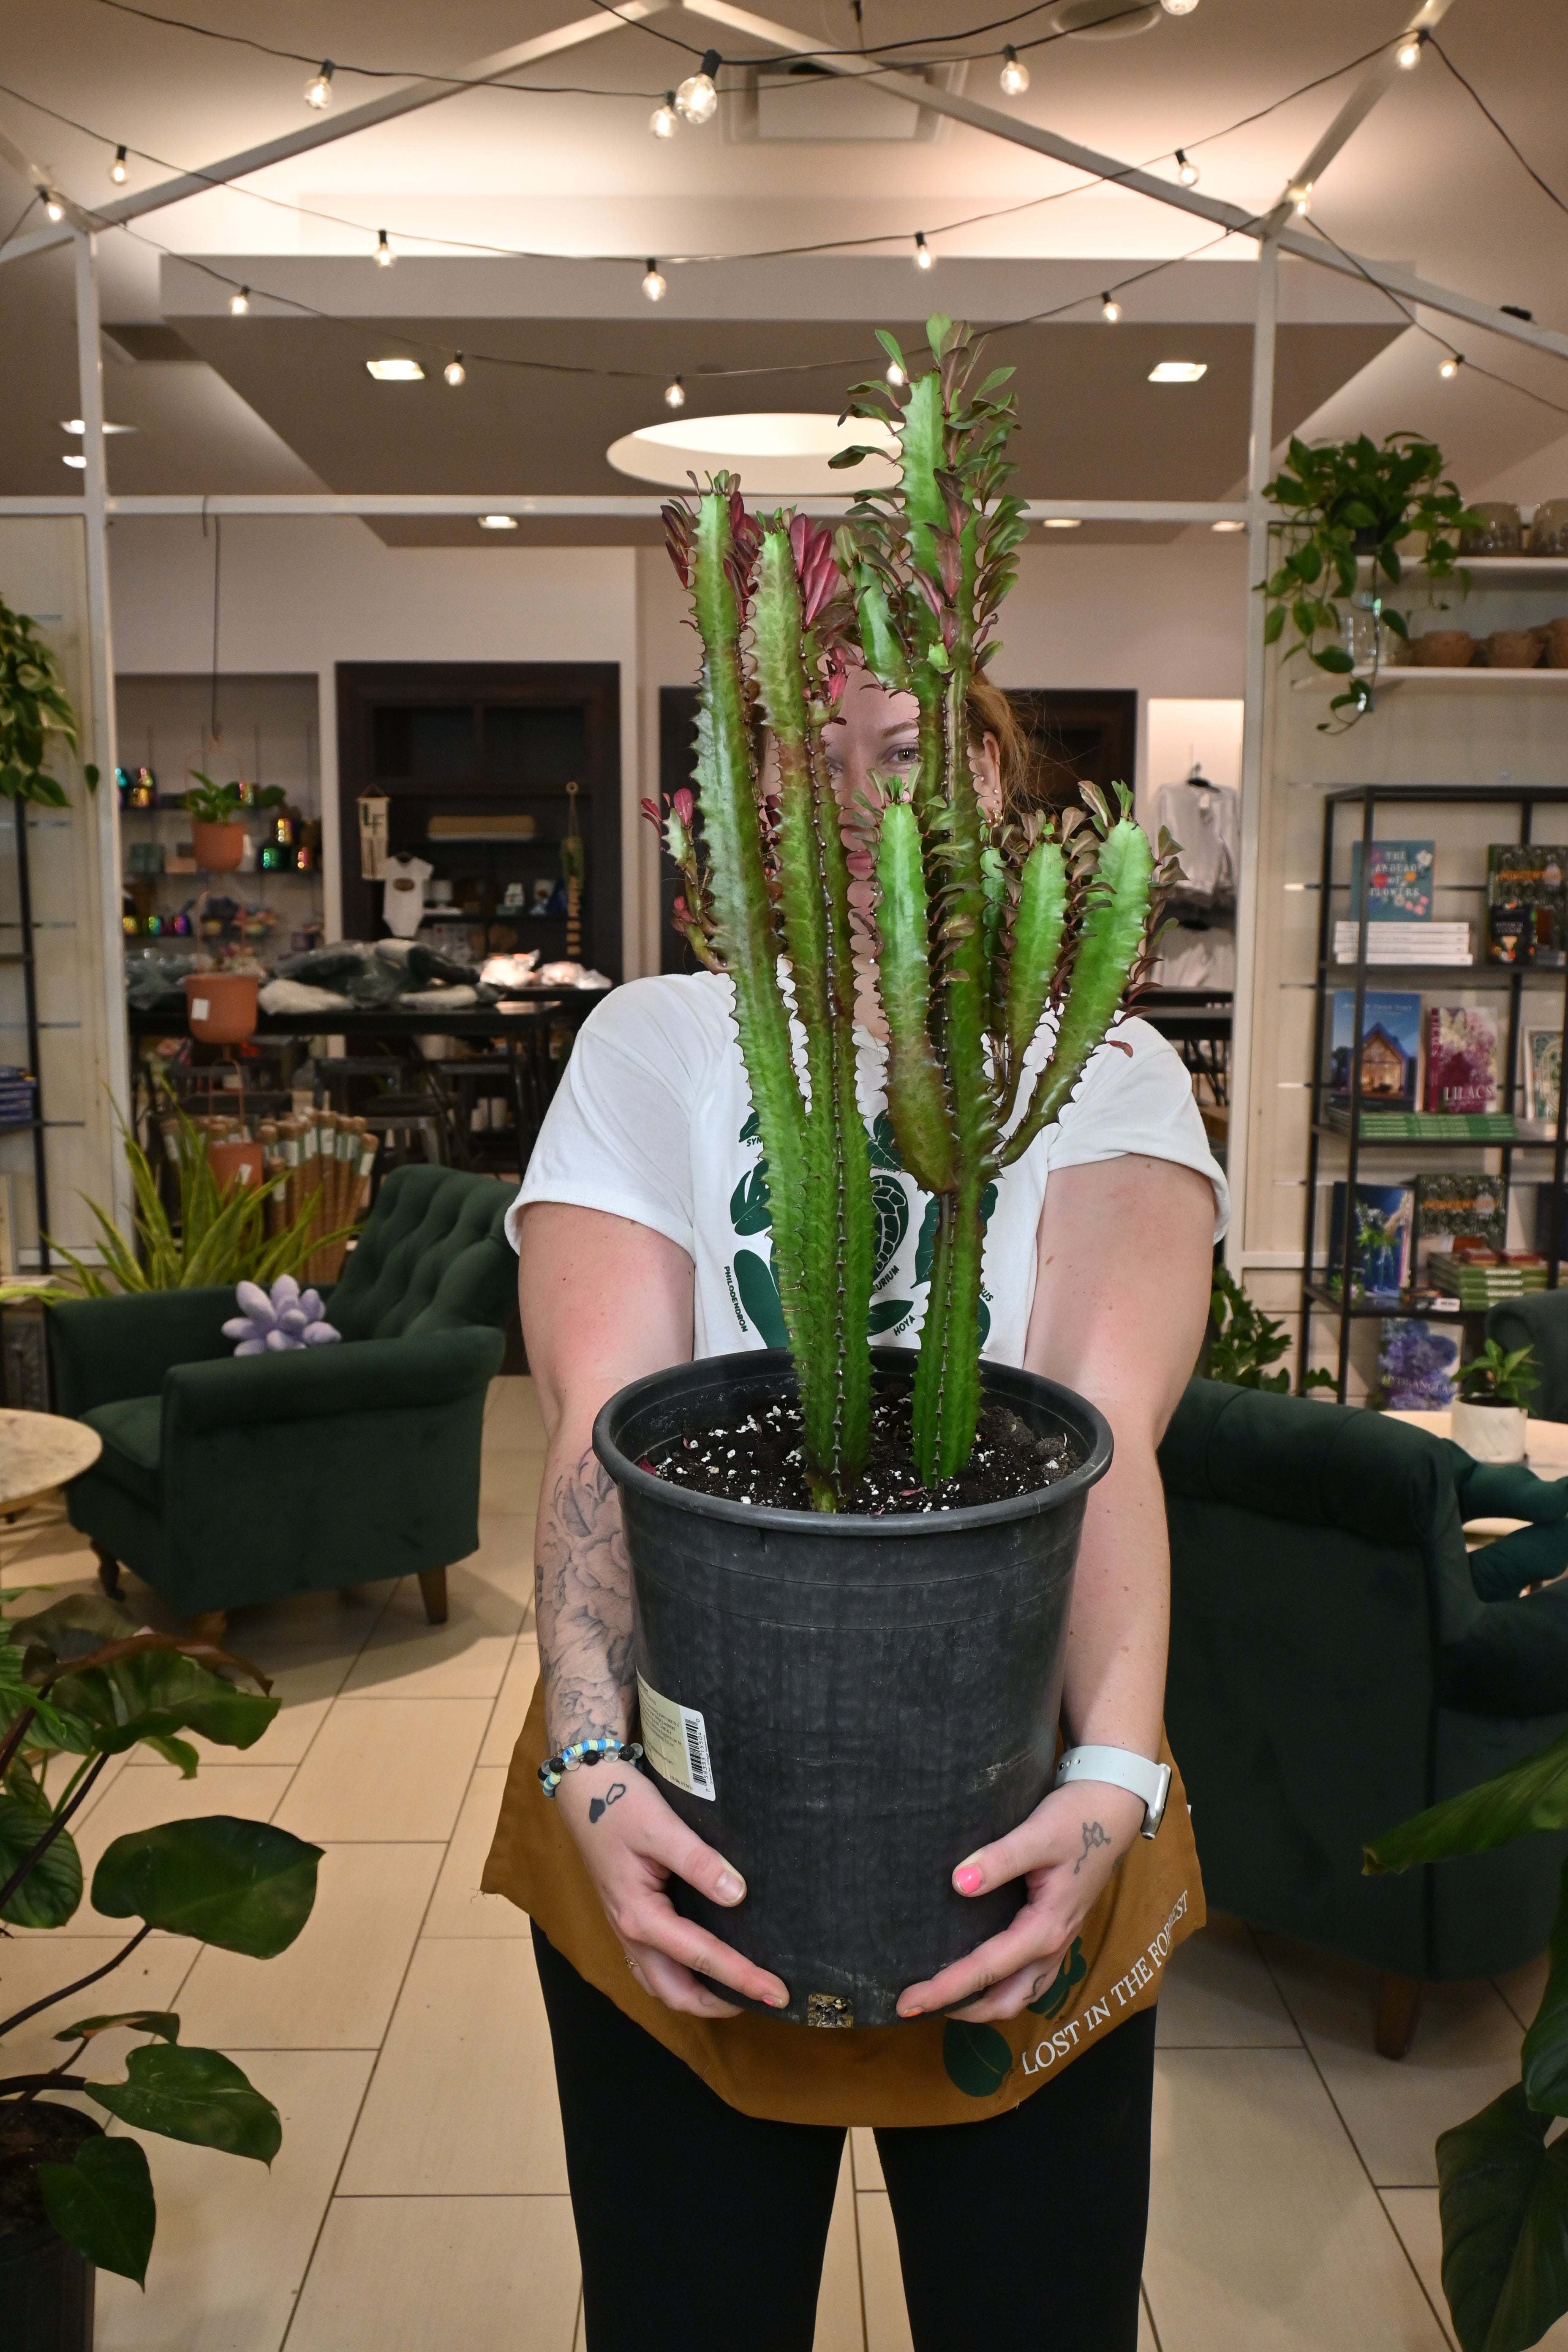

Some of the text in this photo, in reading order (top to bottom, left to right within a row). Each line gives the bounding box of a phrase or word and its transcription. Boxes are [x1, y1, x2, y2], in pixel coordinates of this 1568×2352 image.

[1386, 851, 1406, 859] THE
[1443, 1084, 1496, 1101] LILACS
[874, 1265, 900, 1290] URIUM
[724, 1266, 748, 1332] PHILODENDRON
[981, 1287, 994, 1301] US
[893, 1315, 915, 1336] HOYA
[1021, 1889, 1188, 2075] LOST IN THE FOREST
